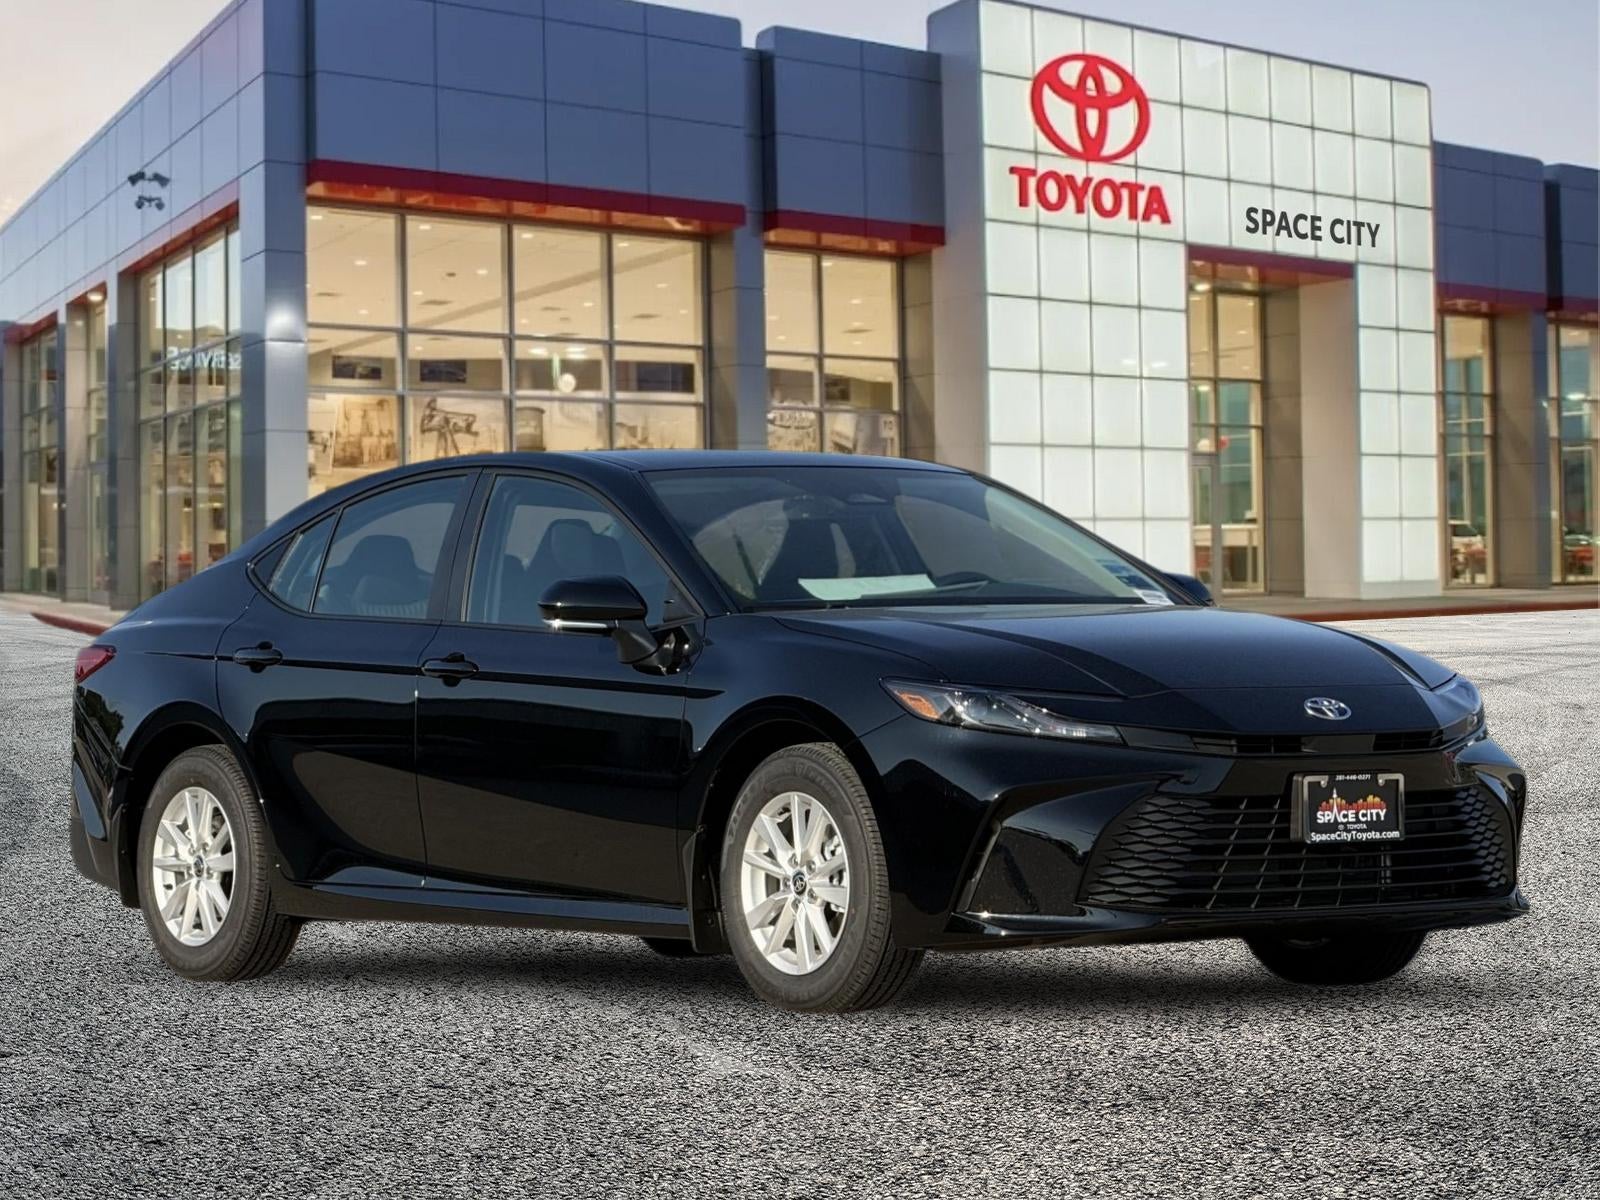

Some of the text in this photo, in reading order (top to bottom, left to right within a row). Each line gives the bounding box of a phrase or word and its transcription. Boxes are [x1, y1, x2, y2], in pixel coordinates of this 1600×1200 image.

[1009, 166, 1171, 224] TOYOTA
[1245, 206, 1380, 248] SPACE CITY
[1316, 809, 1387, 823] SPACE CITY
[1311, 831, 1400, 841] SpaceCityToyota.com
